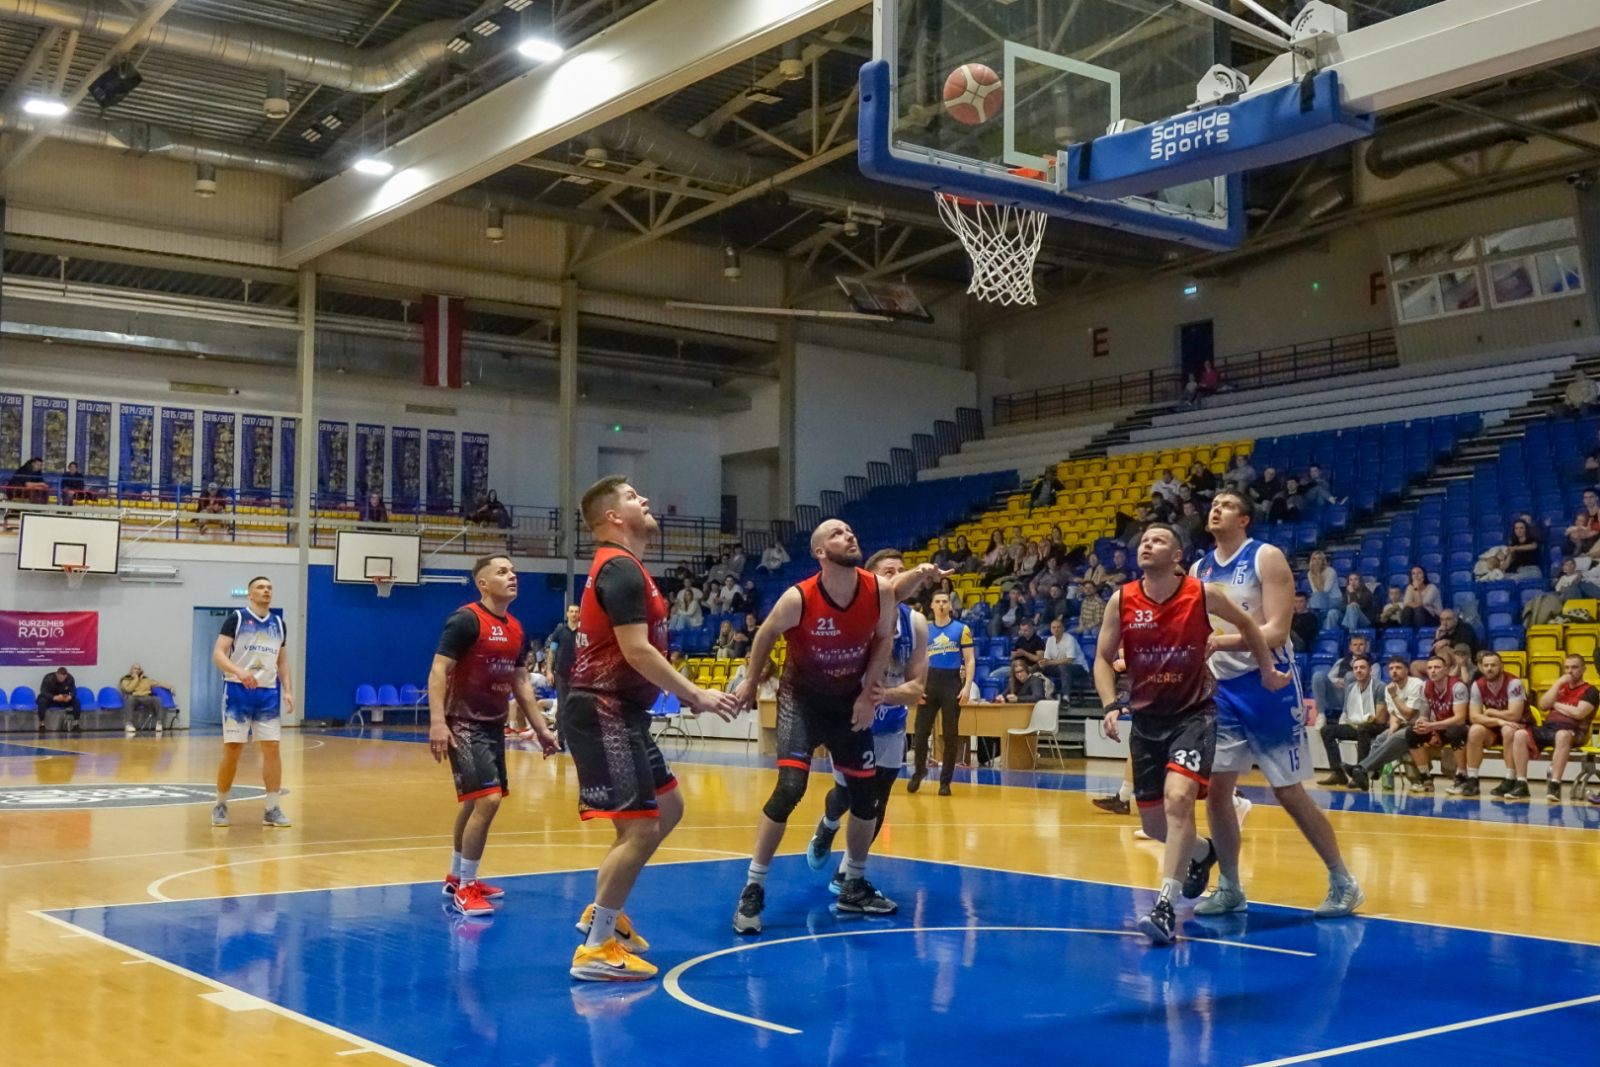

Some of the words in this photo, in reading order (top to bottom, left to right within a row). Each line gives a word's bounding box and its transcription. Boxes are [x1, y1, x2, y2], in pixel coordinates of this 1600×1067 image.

[1151, 112, 1230, 144] Schelde
[1150, 128, 1229, 161] Sports
[1370, 271, 1386, 305] F
[1093, 328, 1109, 358] E
[33, 398, 67, 409] 2012/2013
[77, 402, 111, 413] 2013/2014
[120, 405, 153, 416] 2014/2015
[162, 410, 194, 420] 2015/2016
[203, 413, 235, 423] 2016/2017
[1231, 564, 1248, 586] 15
[1134, 609, 1154, 623] 33
[18, 619, 64, 627] KURZEMES
[817, 617, 835, 630] 21
[18, 627, 64, 638] RADIO
[491, 625, 504, 636] 23
[244, 645, 278, 655] VENTSPILS
[1174, 749, 1202, 772] 33
[1288, 747, 1300, 772] 15
